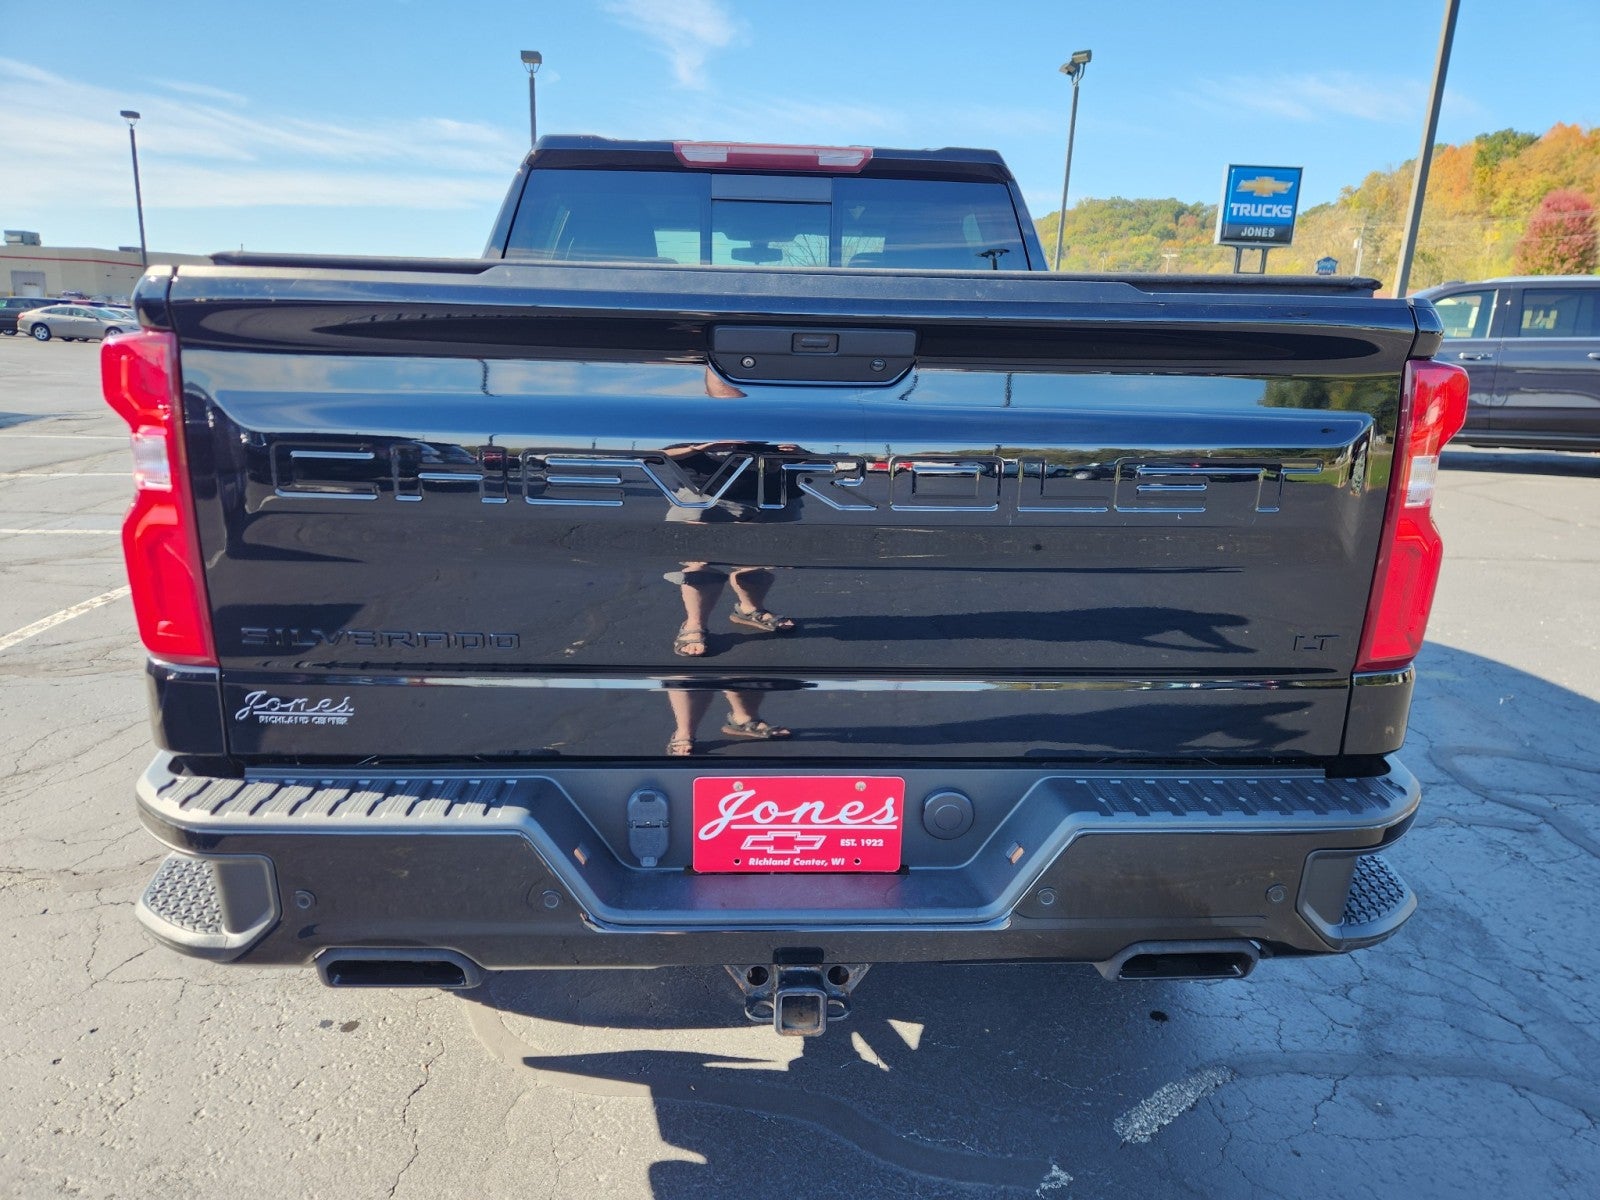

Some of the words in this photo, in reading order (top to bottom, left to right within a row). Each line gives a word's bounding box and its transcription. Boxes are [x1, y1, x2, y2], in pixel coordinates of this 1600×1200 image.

[1230, 202, 1293, 218] TRUCKS
[1240, 226, 1276, 237] JONES
[271, 441, 1324, 513] CHEVROLET
[240, 626, 521, 649] SILVERADO
[1293, 634, 1340, 651] LT
[235, 690, 355, 721] Jones
[258, 715, 309, 725] RICHLAND
[311, 716, 349, 726] CENTER
[698, 789, 899, 841] Jones
[840, 838, 858, 847] EST.
[860, 838, 884, 847] 1922
[748, 857, 791, 866] Richland
[792, 857, 829, 867] Center,
[831, 857, 846, 866] WI
